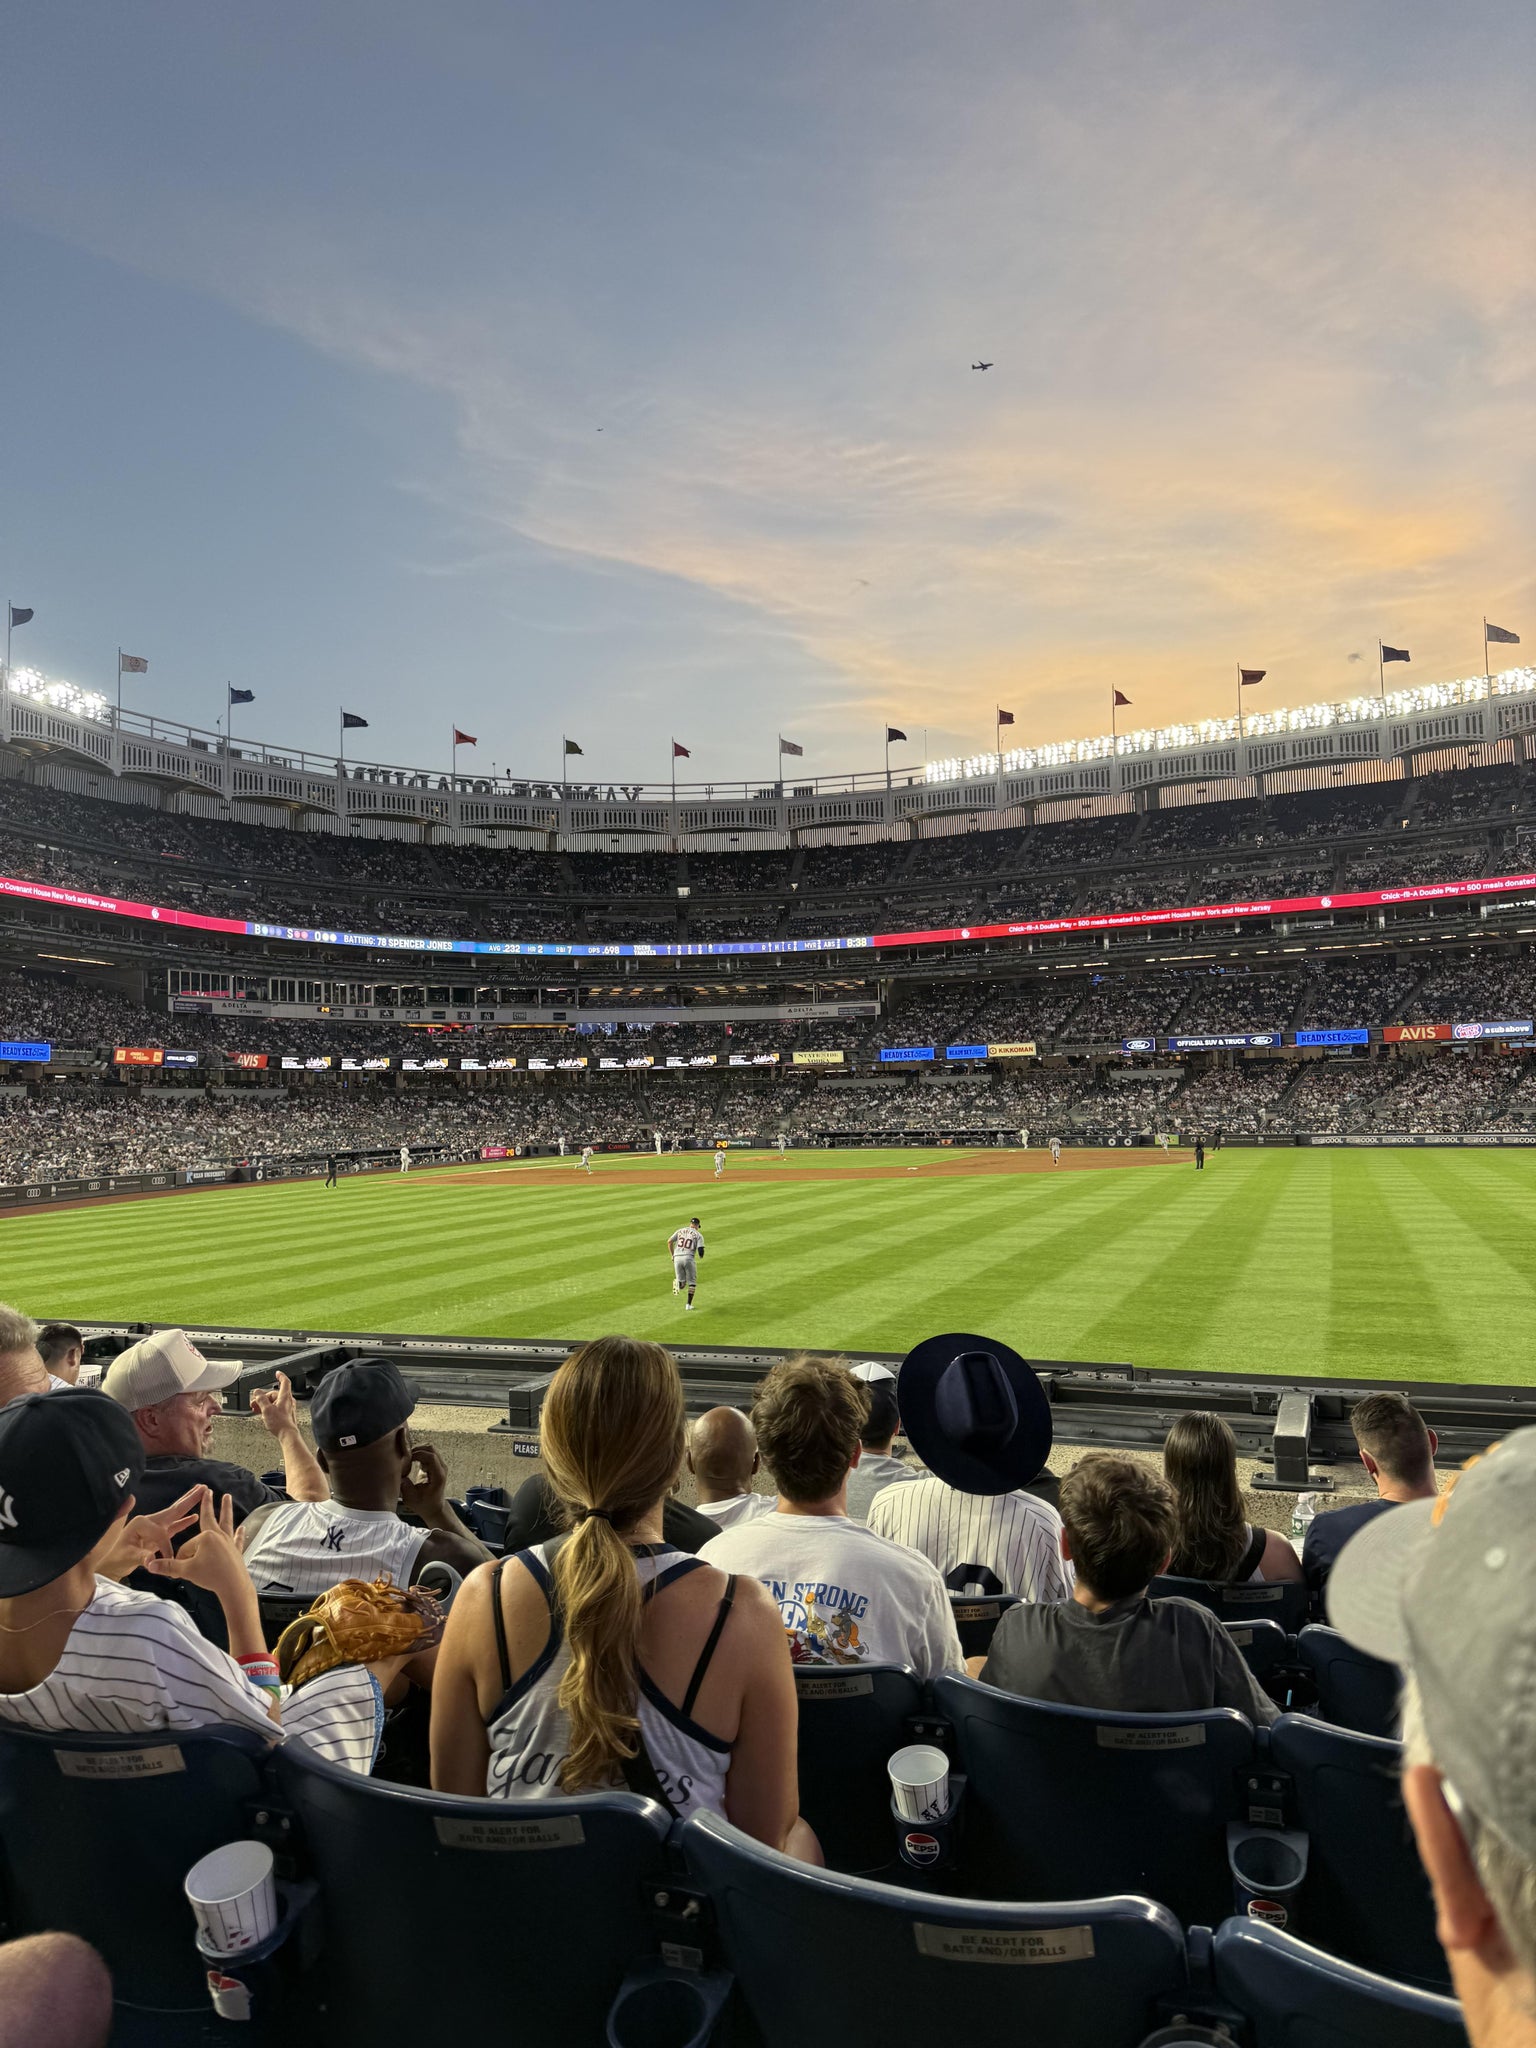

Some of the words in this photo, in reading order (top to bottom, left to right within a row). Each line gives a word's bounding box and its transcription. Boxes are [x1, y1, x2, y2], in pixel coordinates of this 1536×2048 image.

[1381, 891, 1418, 900] Chick-fil-A
[1419, 888, 1444, 897] Double
[1445, 886, 1459, 895] Play
[1483, 881, 1504, 889] meals
[1505, 877, 1535, 887] donated
[5, 882, 32, 894] Covenant
[33, 887, 51, 898] House
[52, 891, 64, 899] New
[65, 893, 77, 902] York
[77, 896, 88, 904] and
[88, 898, 100, 907] New
[100, 900, 117, 911] Jersey
[1008, 924, 1039, 933] Chick-fil-A
[1040, 922, 1059, 931] Double
[1060, 921, 1073, 930] Play
[1108, 916, 1132, 924] donated
[1141, 913, 1171, 922] Covenant
[1171, 911, 1190, 919] House
[1221, 906, 1233, 914] and
[1234, 905, 1249, 913] New
[1250, 904, 1271, 913] Jersey
[254, 924, 261, 935] B
[287, 929, 294, 939] S
[344, 935, 376, 946] BATTING:
[377, 938, 387, 946] 78
[388, 938, 425, 949] SPENCER
[426, 941, 453, 950] JONES
[846, 937, 867, 947] 8:38
[502, 944, 521, 953] .232
[537, 945, 543, 953] 2
[567, 945, 572, 954] 7
[602, 945, 620, 955] .698
[1400, 1027, 1436, 1040] AVIS
[1505, 1025, 1529, 1033] above
[1176, 1039, 1204, 1047] OFFICIAL
[1301, 1033, 1326, 1043] READY
[1326, 1033, 1341, 1042] SET
[22, 1047, 32, 1056] SET
[884, 1050, 903, 1059] READY
[903, 1050, 914, 1058] SET
[998, 1046, 1034, 1054] KIKKOMAN
[237, 1054, 258, 1067] AVIS
[678, 1237, 692, 1249] 30
[514, 1444, 539, 1455] PLEASE
[793, 1583, 869, 1619] STRONG
[135, 1761, 163, 1771] BALLS
[488, 1826, 518, 1836] ALERT
[520, 1825, 541, 1834] FOR
[458, 1833, 483, 1843] BATS
[485, 1835, 526, 1845] AND/OR
[528, 1833, 561, 1843] BALLS
[907, 1841, 938, 1853] PEPSI
[1250, 1907, 1285, 1921] PEPSI
[962, 1935, 978, 1945] BE
[981, 1936, 1018, 1947] ALERT
[1021, 1936, 1044, 1946] FOR
[943, 1943, 973, 1955] BATS
[977, 1946, 1026, 1957] AND/OR
[1029, 1945, 1066, 1957] BALLS
